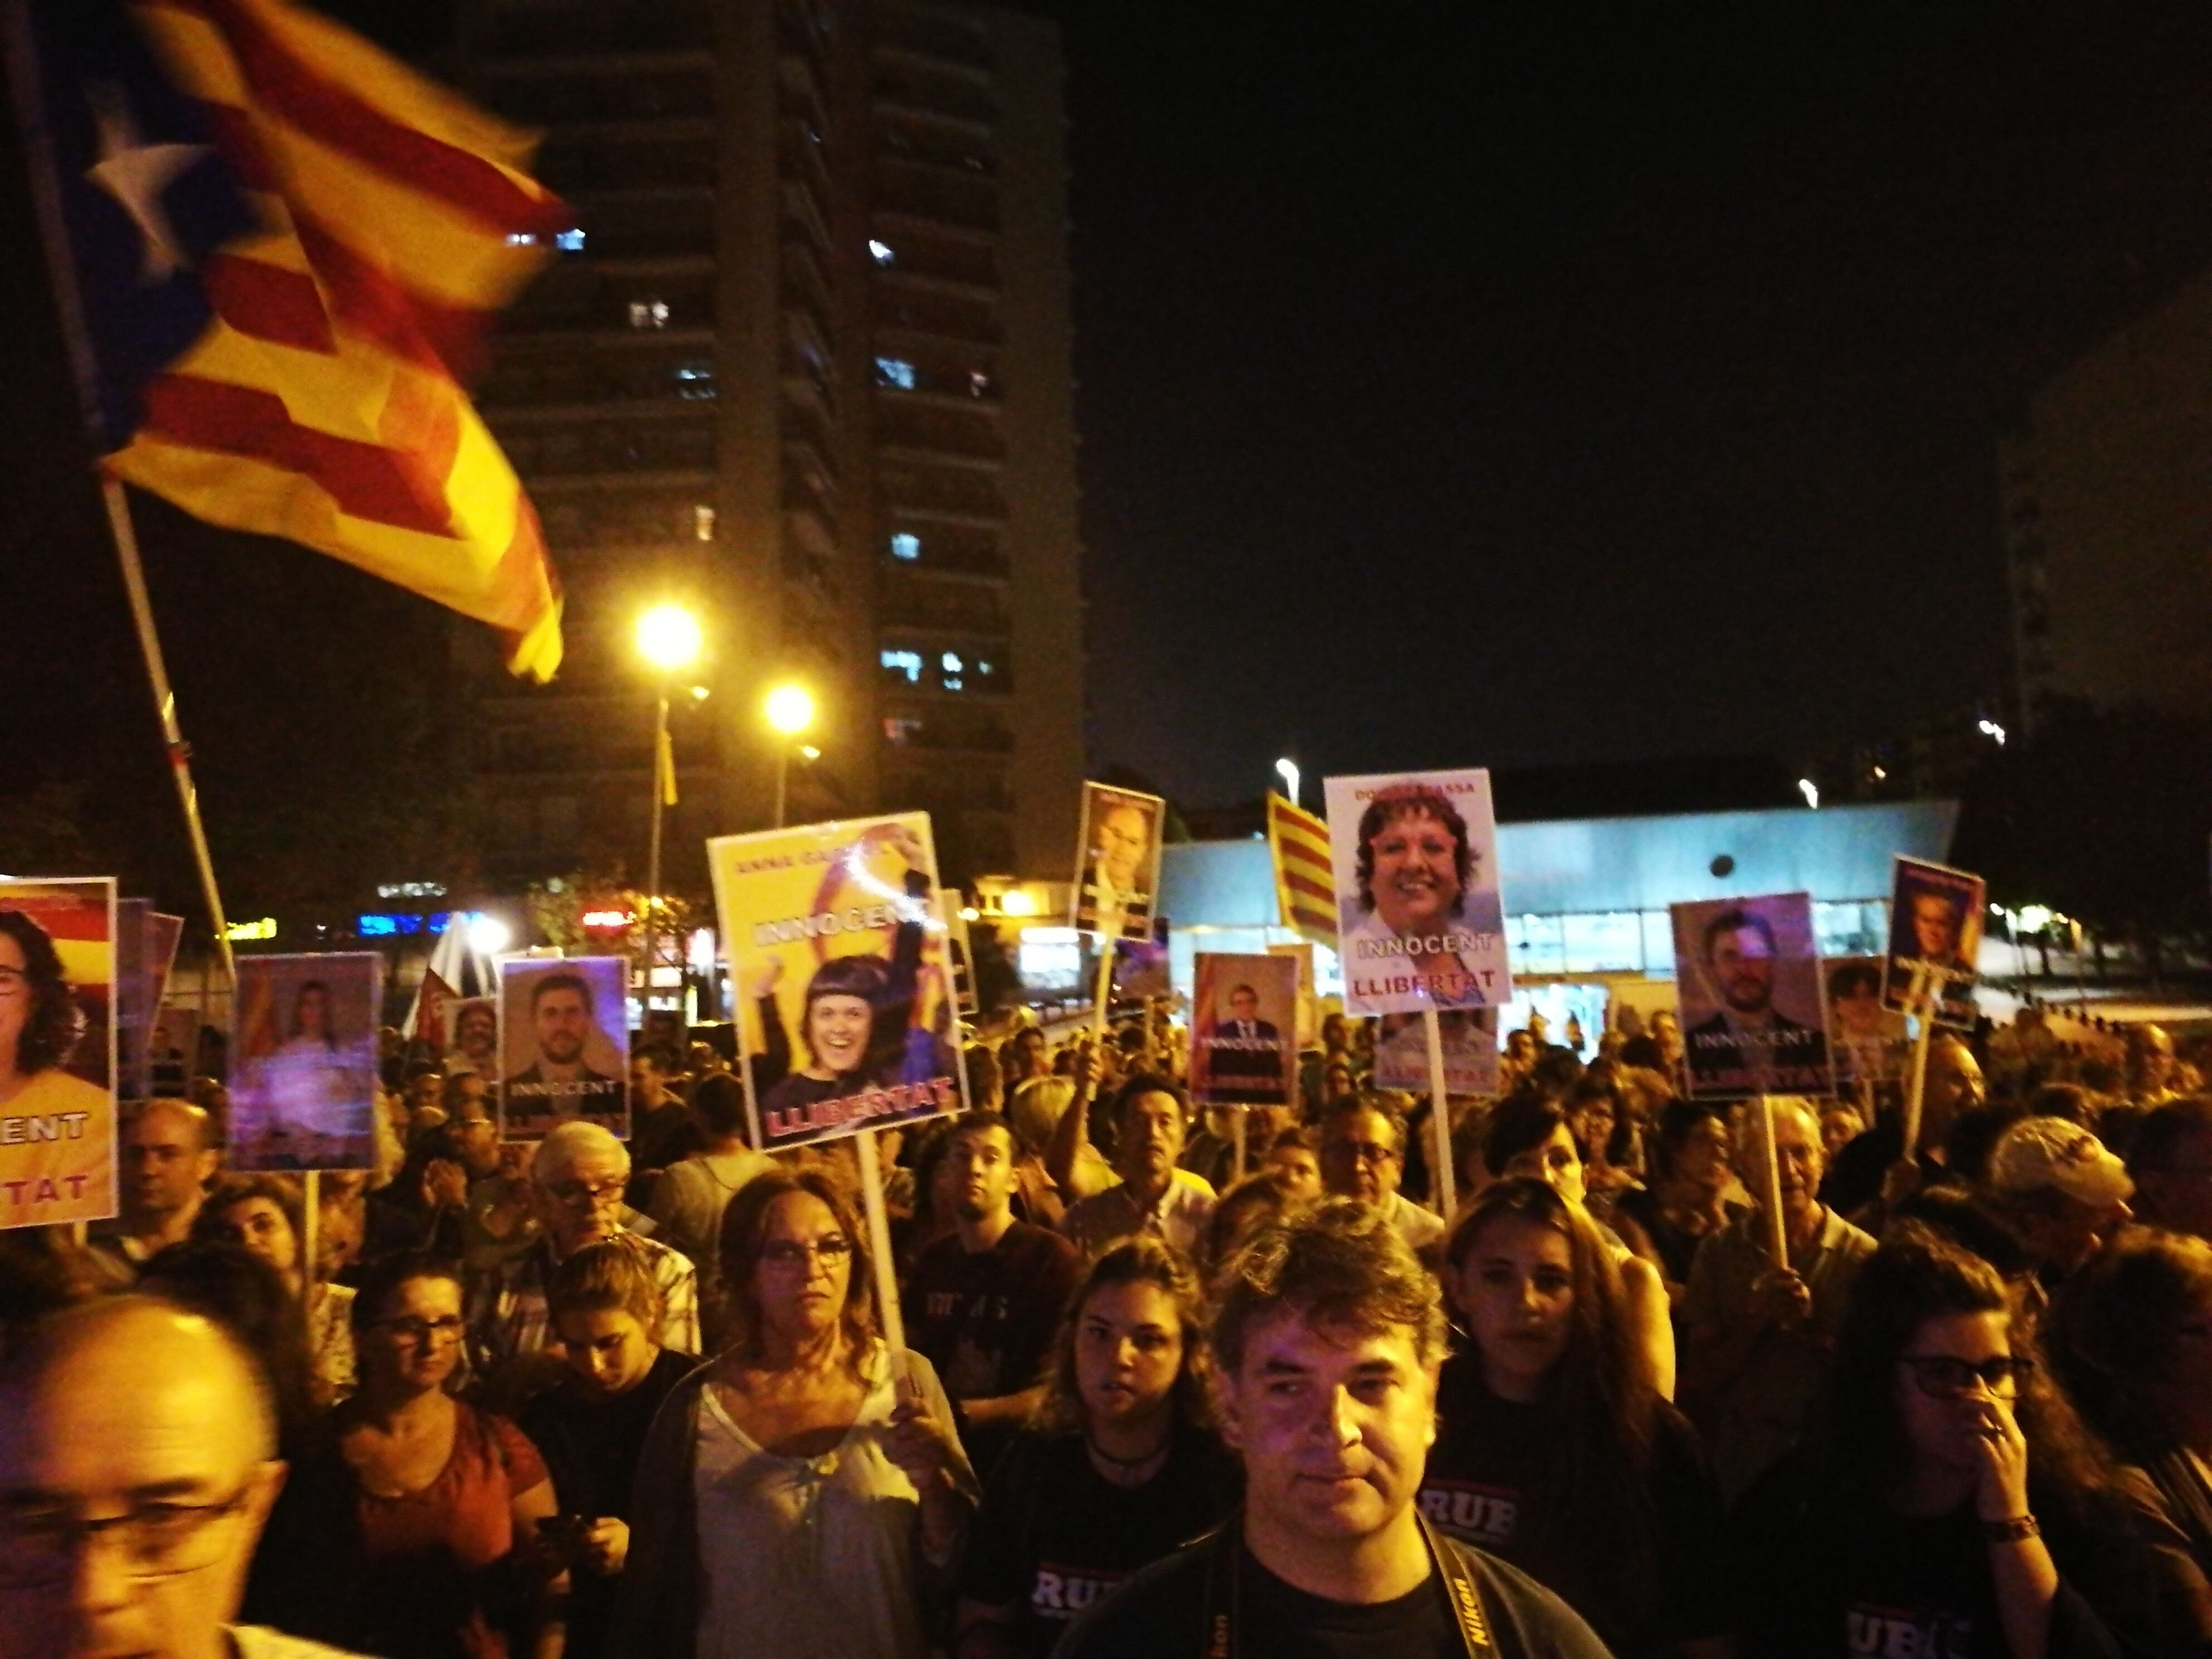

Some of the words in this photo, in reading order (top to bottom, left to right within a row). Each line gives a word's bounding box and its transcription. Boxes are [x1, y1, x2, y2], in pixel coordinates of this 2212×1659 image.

[1356, 933, 1492, 959] INNOCENT
[1353, 969, 1496, 997] LLIBERTAT
[765, 1076, 953, 1138] LLIBERTAT
[4, 1174, 87, 1206] TAT
[1453, 1577, 1490, 1646] Nikon
